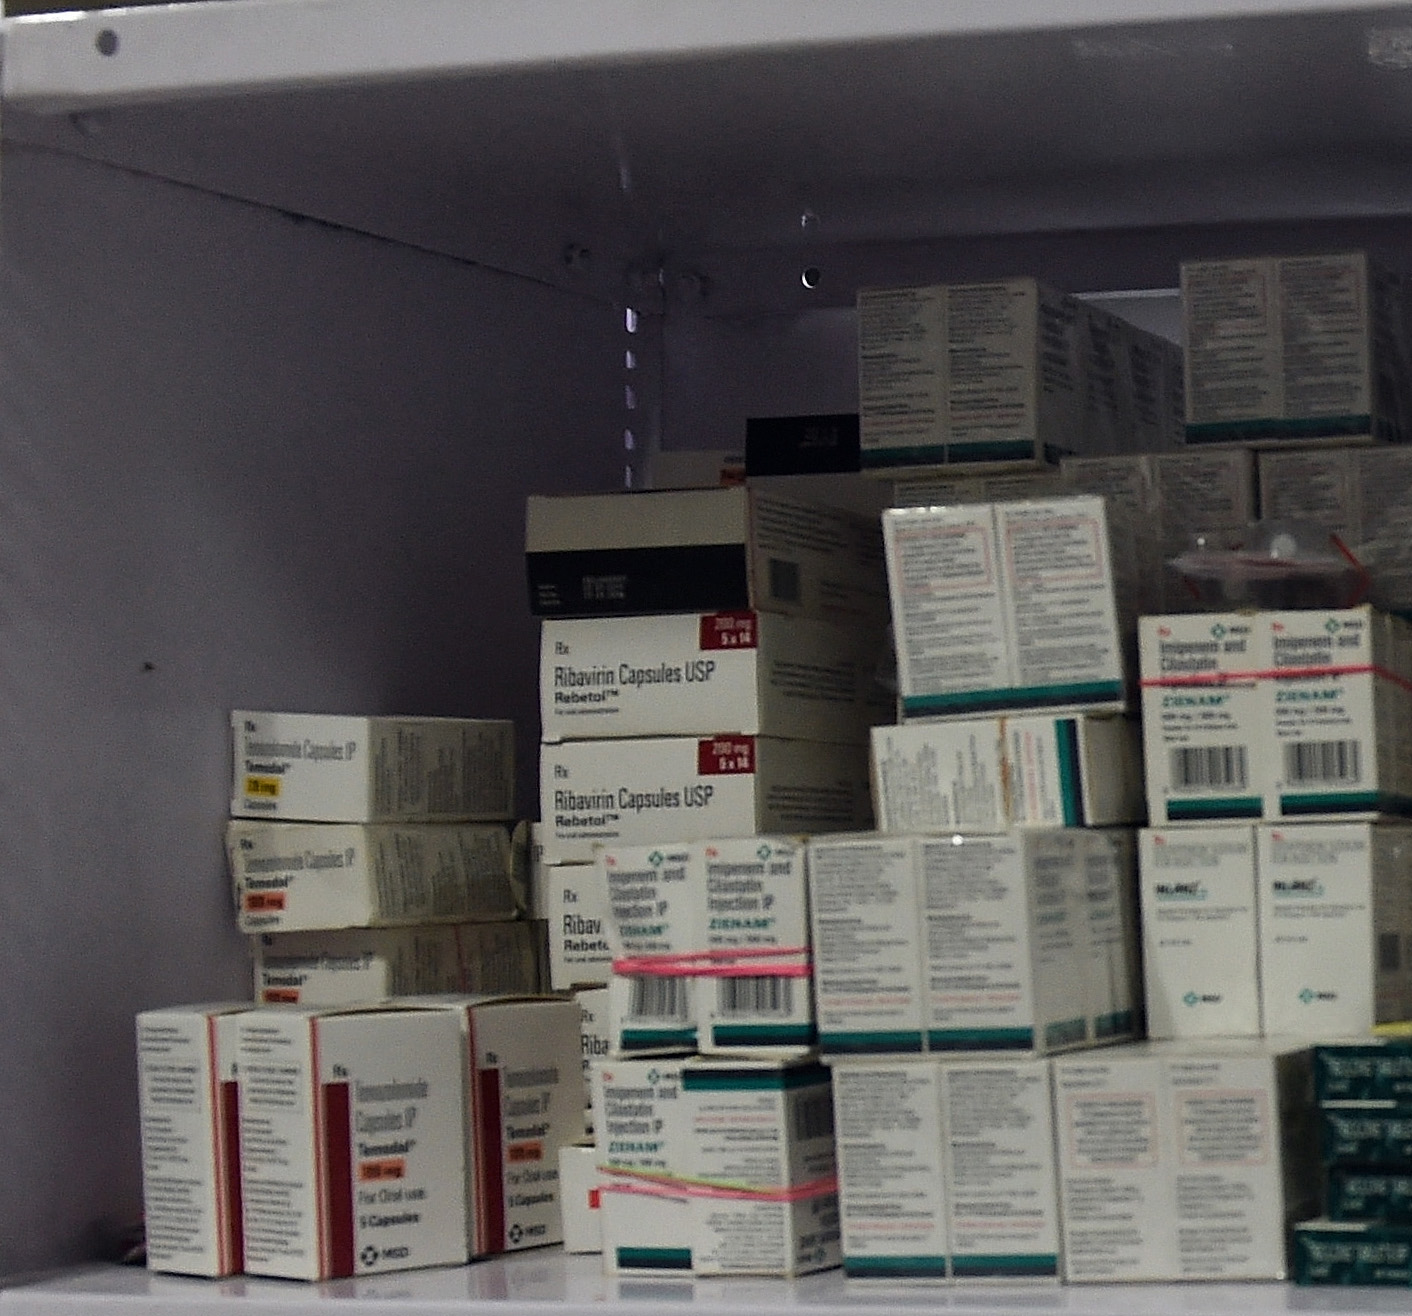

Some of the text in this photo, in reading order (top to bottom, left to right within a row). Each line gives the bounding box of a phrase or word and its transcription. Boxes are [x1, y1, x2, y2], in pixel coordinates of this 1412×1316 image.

[554, 660, 715, 688] Ribavirin Capsules USP
[554, 765, 568, 779] Rx
[554, 785, 714, 813] Ribavirin Capsules USP
[563, 890, 577, 903] Rx
